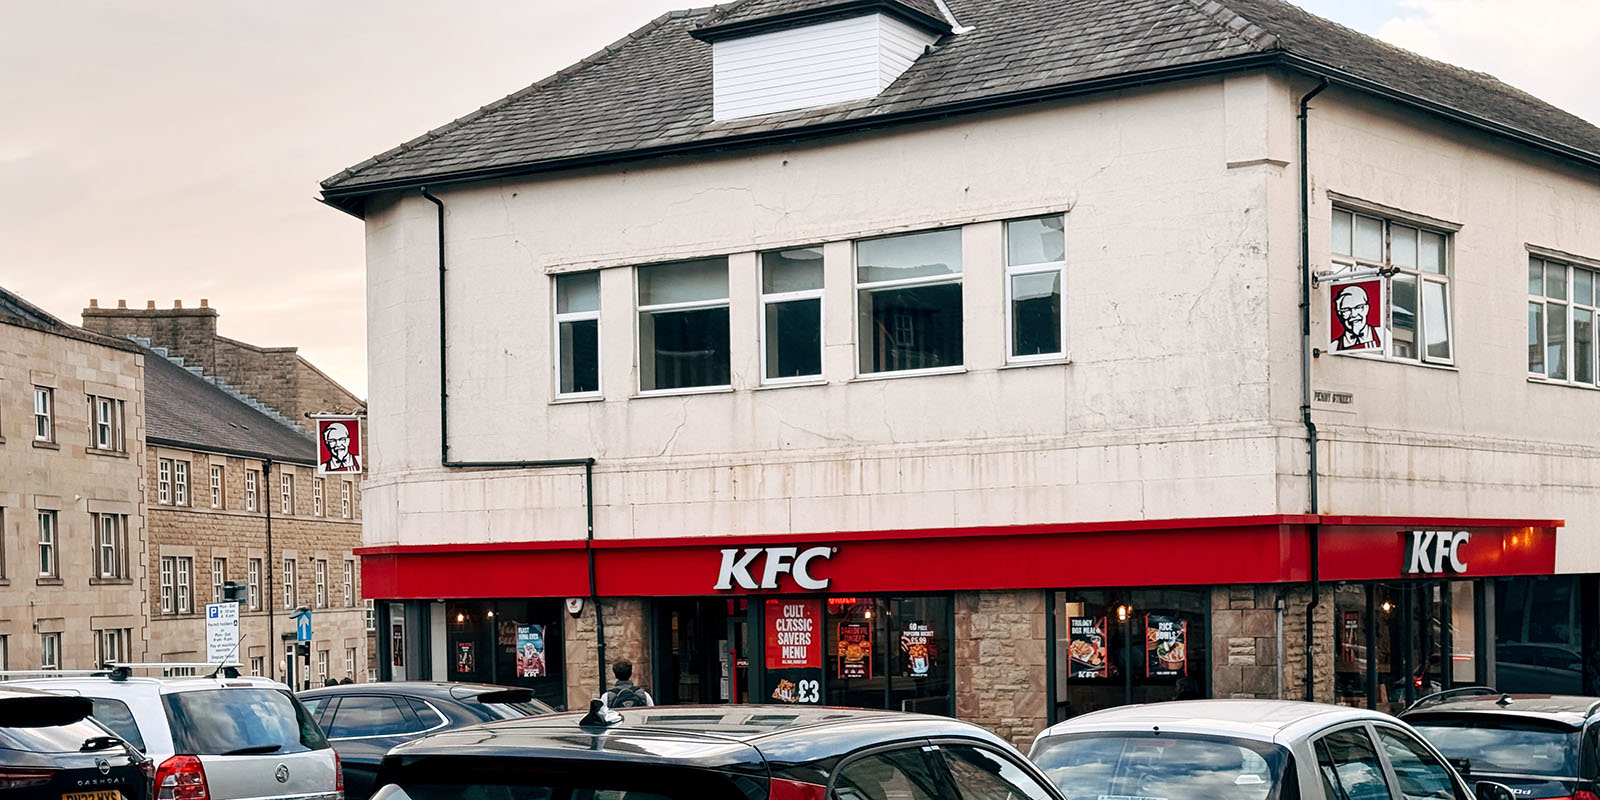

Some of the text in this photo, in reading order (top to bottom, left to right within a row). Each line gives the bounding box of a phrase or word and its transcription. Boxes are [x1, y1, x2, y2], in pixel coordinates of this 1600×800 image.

[1313, 391, 1353, 404] PENNY STREET
[1408, 530, 1470, 574] KFC
[713, 546, 832, 590] KFC
[783, 604, 805, 618] CULT
[775, 618, 813, 632] CLASSIC
[909, 622, 917, 631] 60
[1071, 619, 1093, 627] TRILOGY
[1158, 622, 1173, 631] RICE
[777, 632, 812, 646] SAVERS
[910, 636, 927, 645] £5.99
[1155, 631, 1176, 640] BOWLS
[781, 645, 807, 659] MENU
[798, 679, 820, 703] £3
[77, 777, 125, 786] QASHQAI
